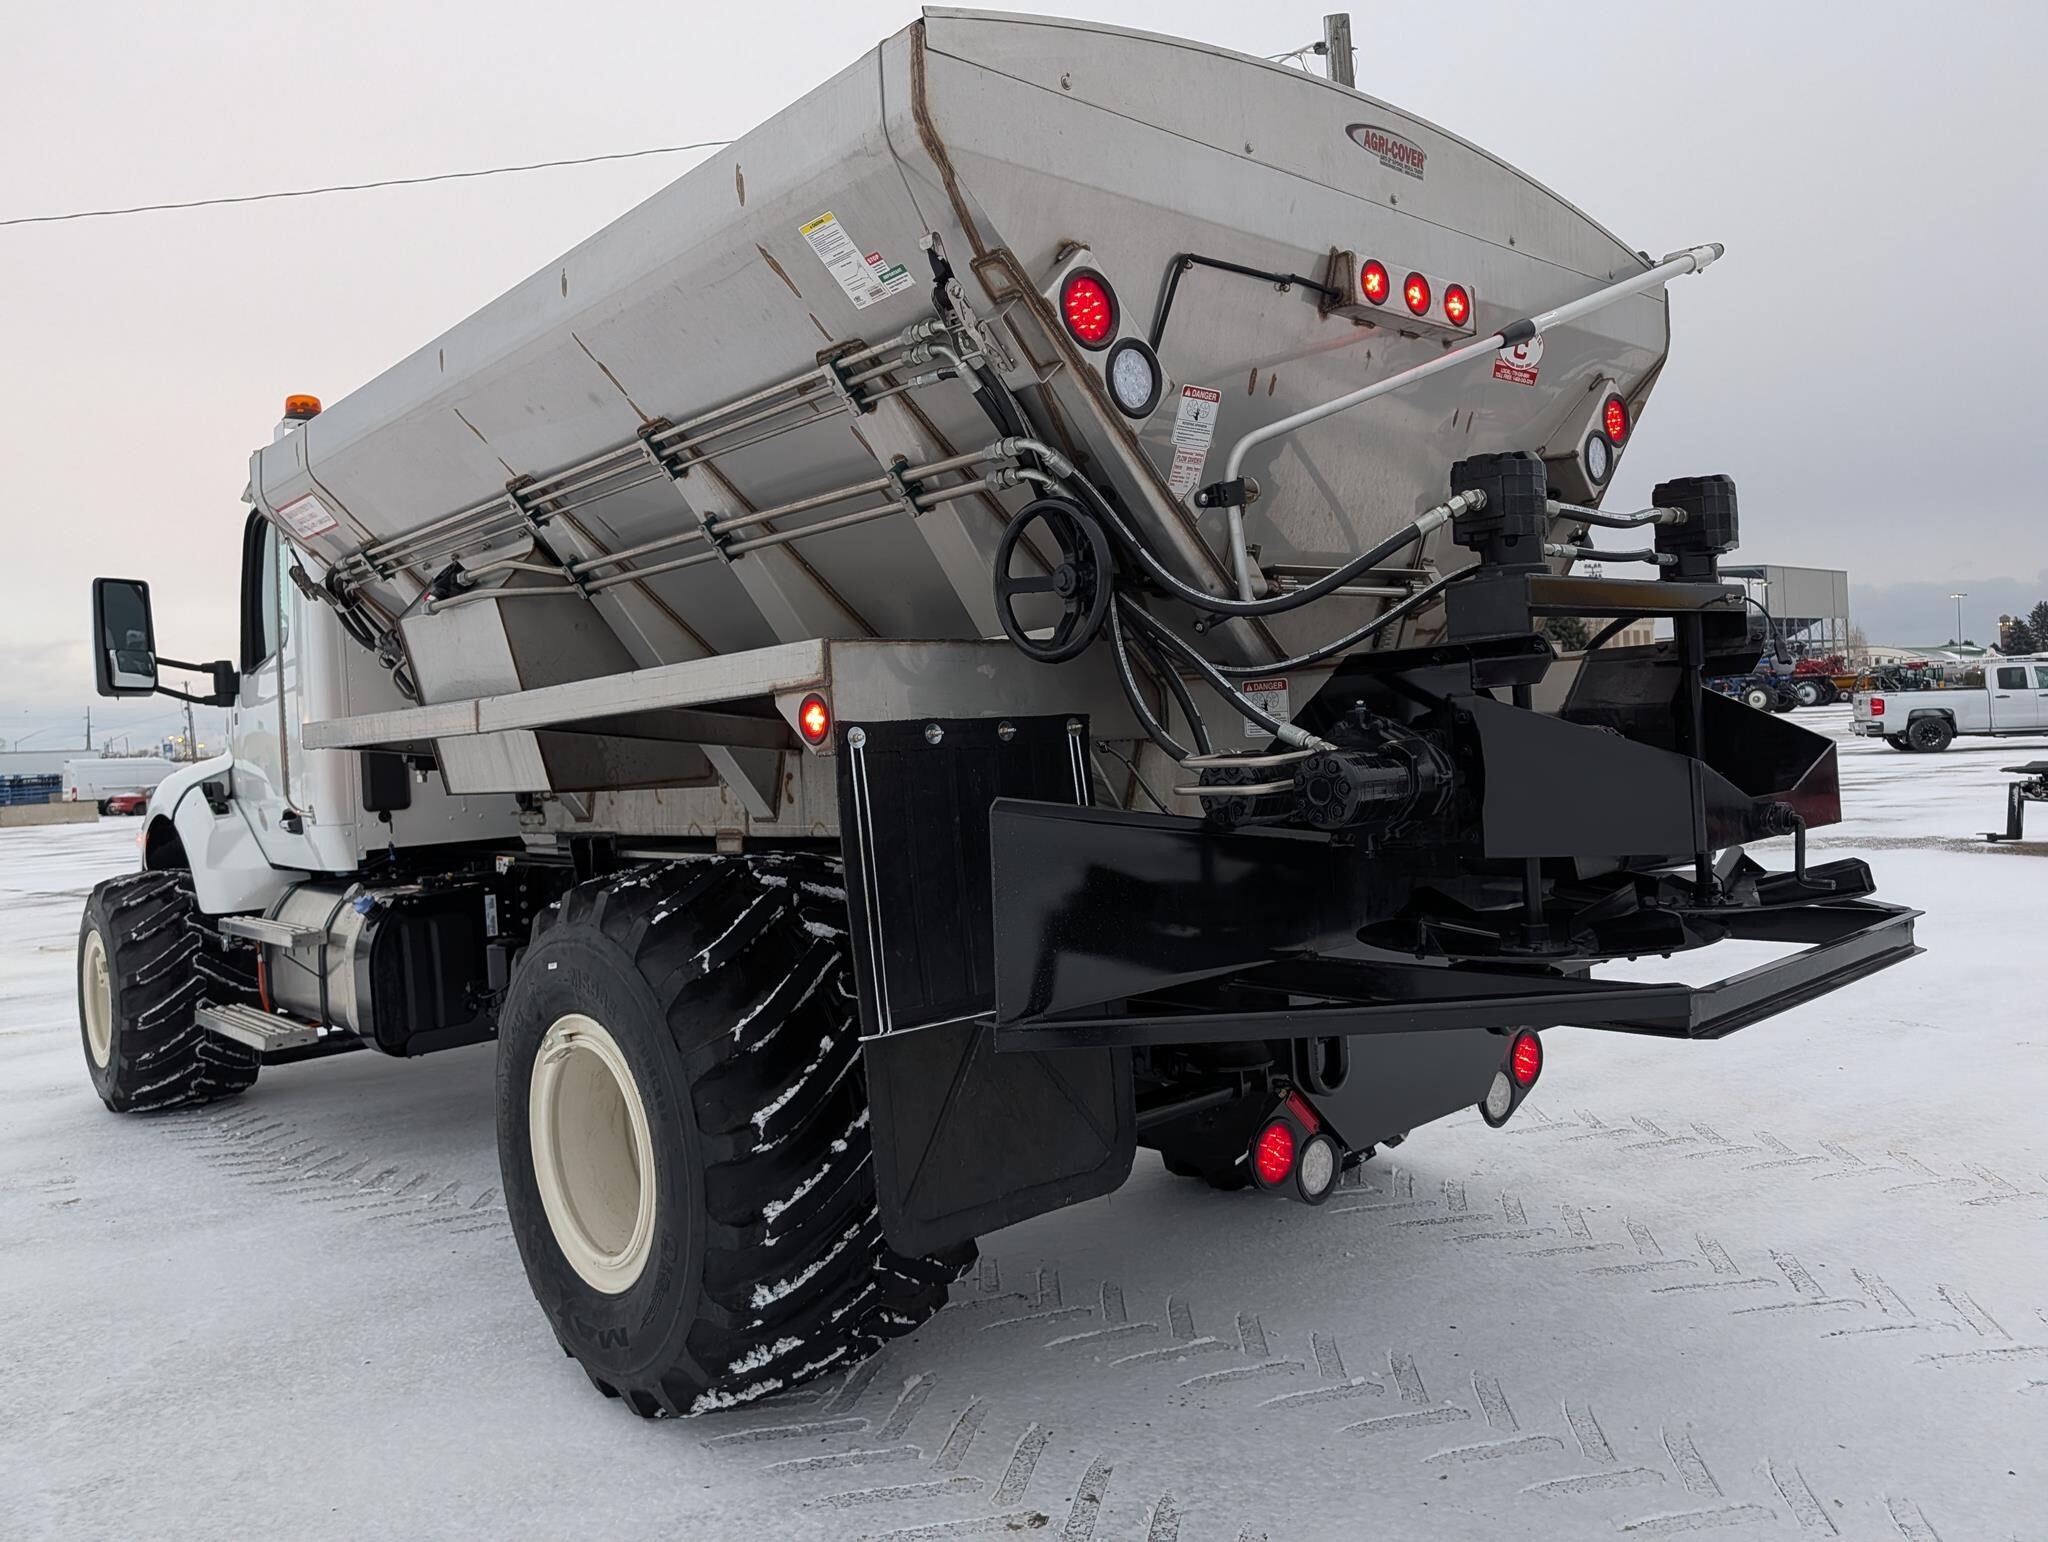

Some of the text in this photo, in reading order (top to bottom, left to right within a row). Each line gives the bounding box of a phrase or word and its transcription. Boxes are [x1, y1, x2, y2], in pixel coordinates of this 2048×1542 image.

[1363, 129, 1425, 170] AGRI-COVER
[867, 254, 880, 264] STOP
[1191, 389, 1218, 401] DANGER
[1253, 681, 1283, 691] DANGER
